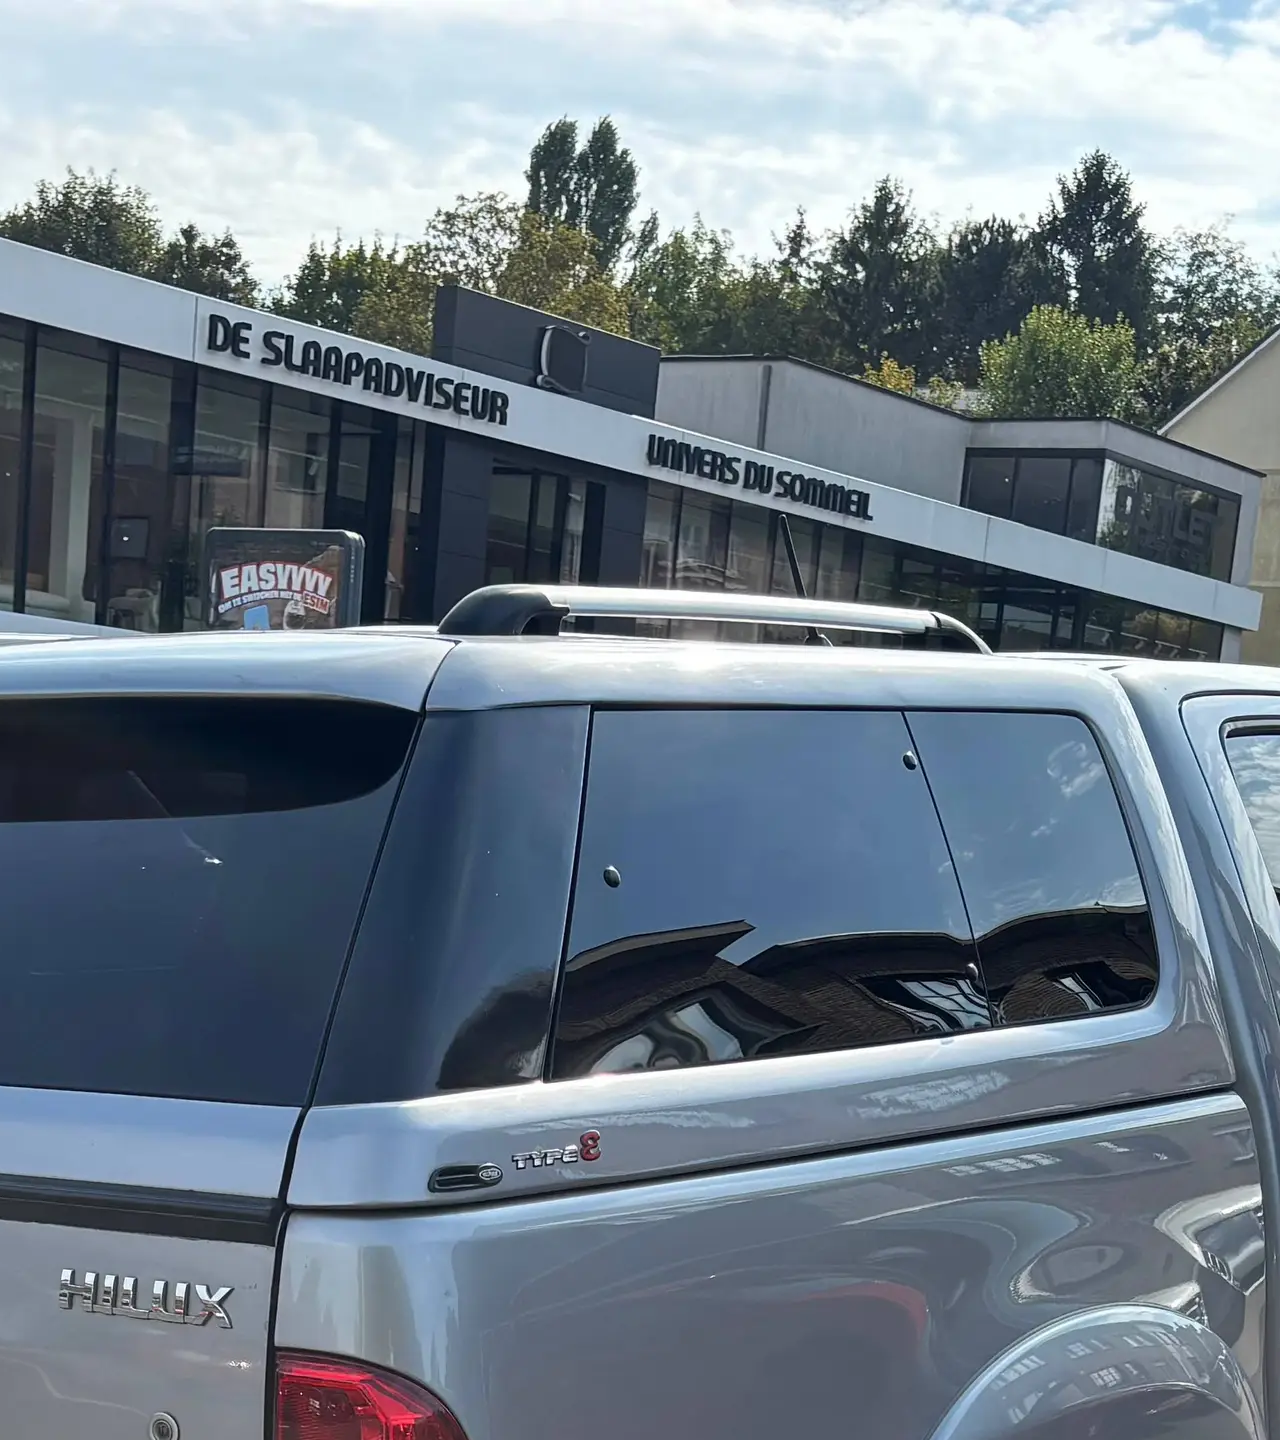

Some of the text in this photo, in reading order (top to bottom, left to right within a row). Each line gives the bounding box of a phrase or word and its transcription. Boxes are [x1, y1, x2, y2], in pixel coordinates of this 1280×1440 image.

[207, 313, 510, 427] DE SLAAPADVISEUR
[646, 434, 874, 521] UNIVERS DU SOMMEIL
[512, 1144, 579, 1170] TYPE
[59, 1267, 236, 1330] HILUX
